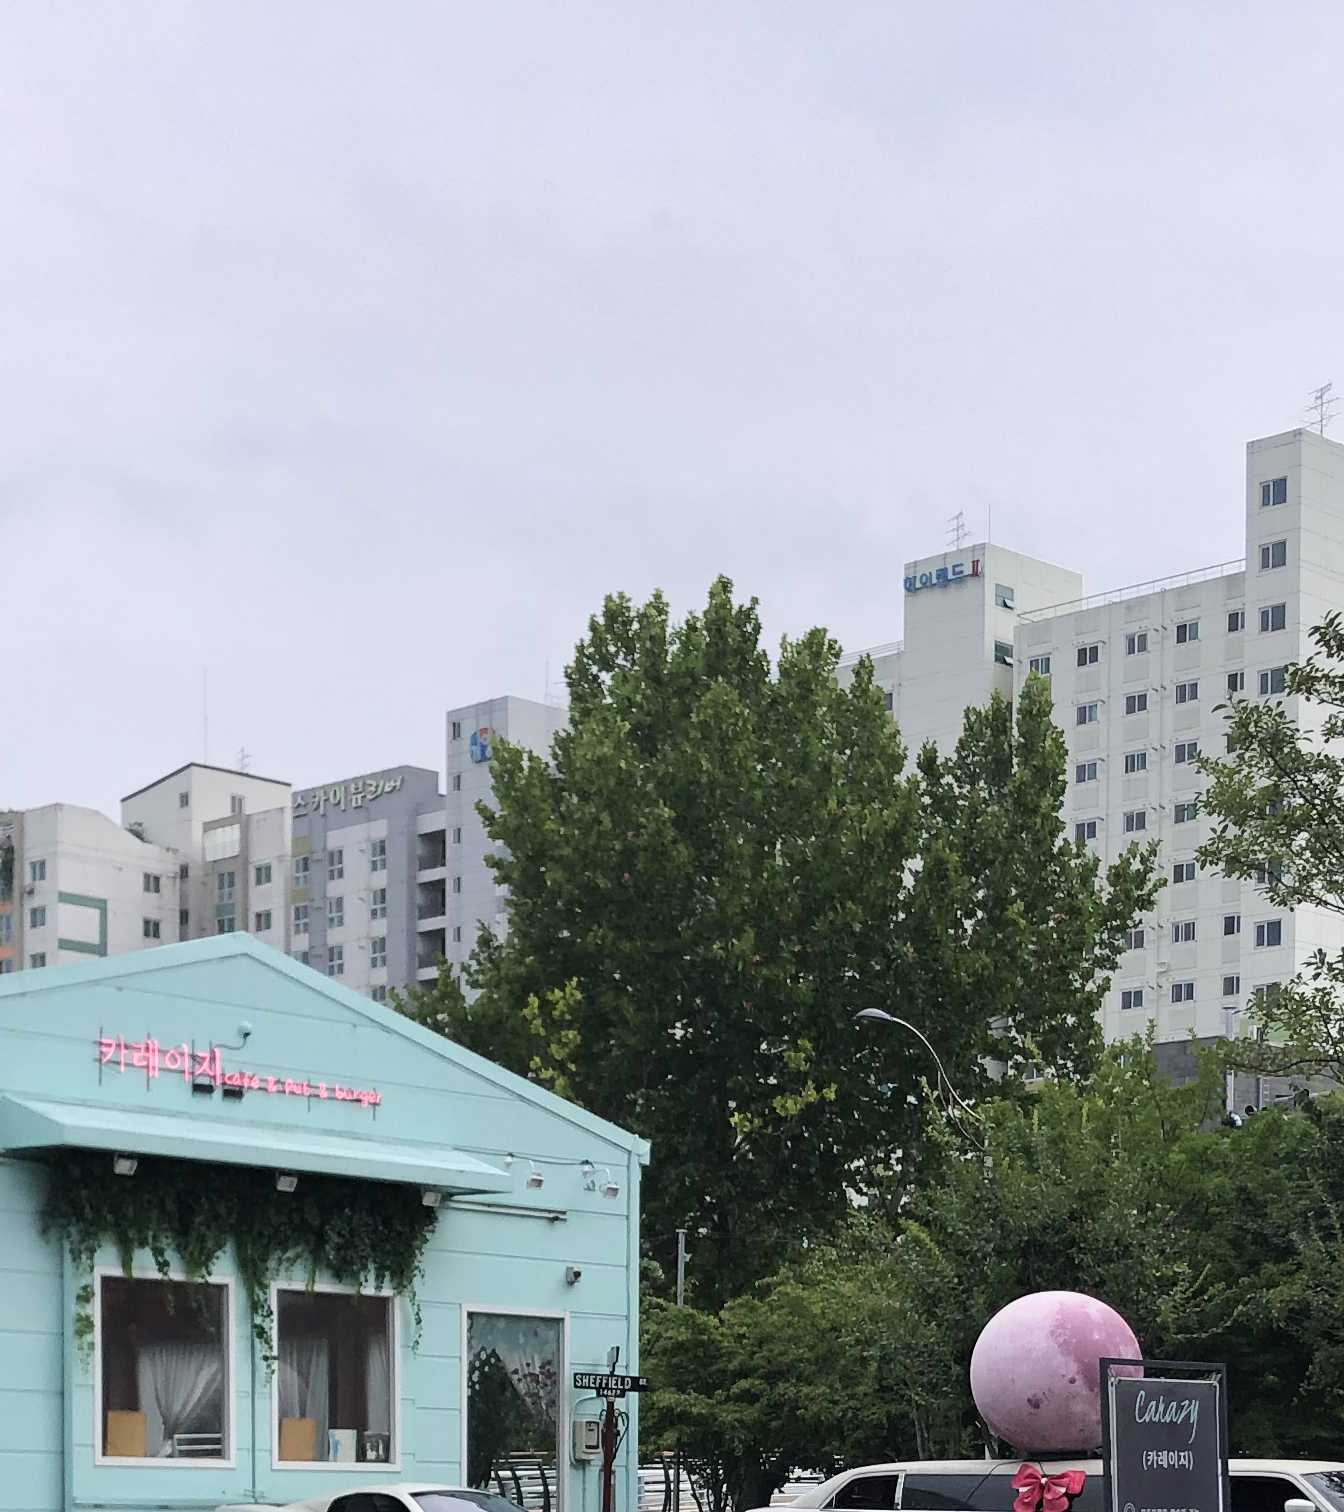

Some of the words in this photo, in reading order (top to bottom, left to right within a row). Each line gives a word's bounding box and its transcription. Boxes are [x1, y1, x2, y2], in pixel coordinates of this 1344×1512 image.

[100, 1034, 221, 1088] 카레이지
[335, 1083, 382, 1107] burger
[575, 1374, 632, 1390] SHEFFIELD
[1143, 1450, 1194, 1471] (카레이지)
